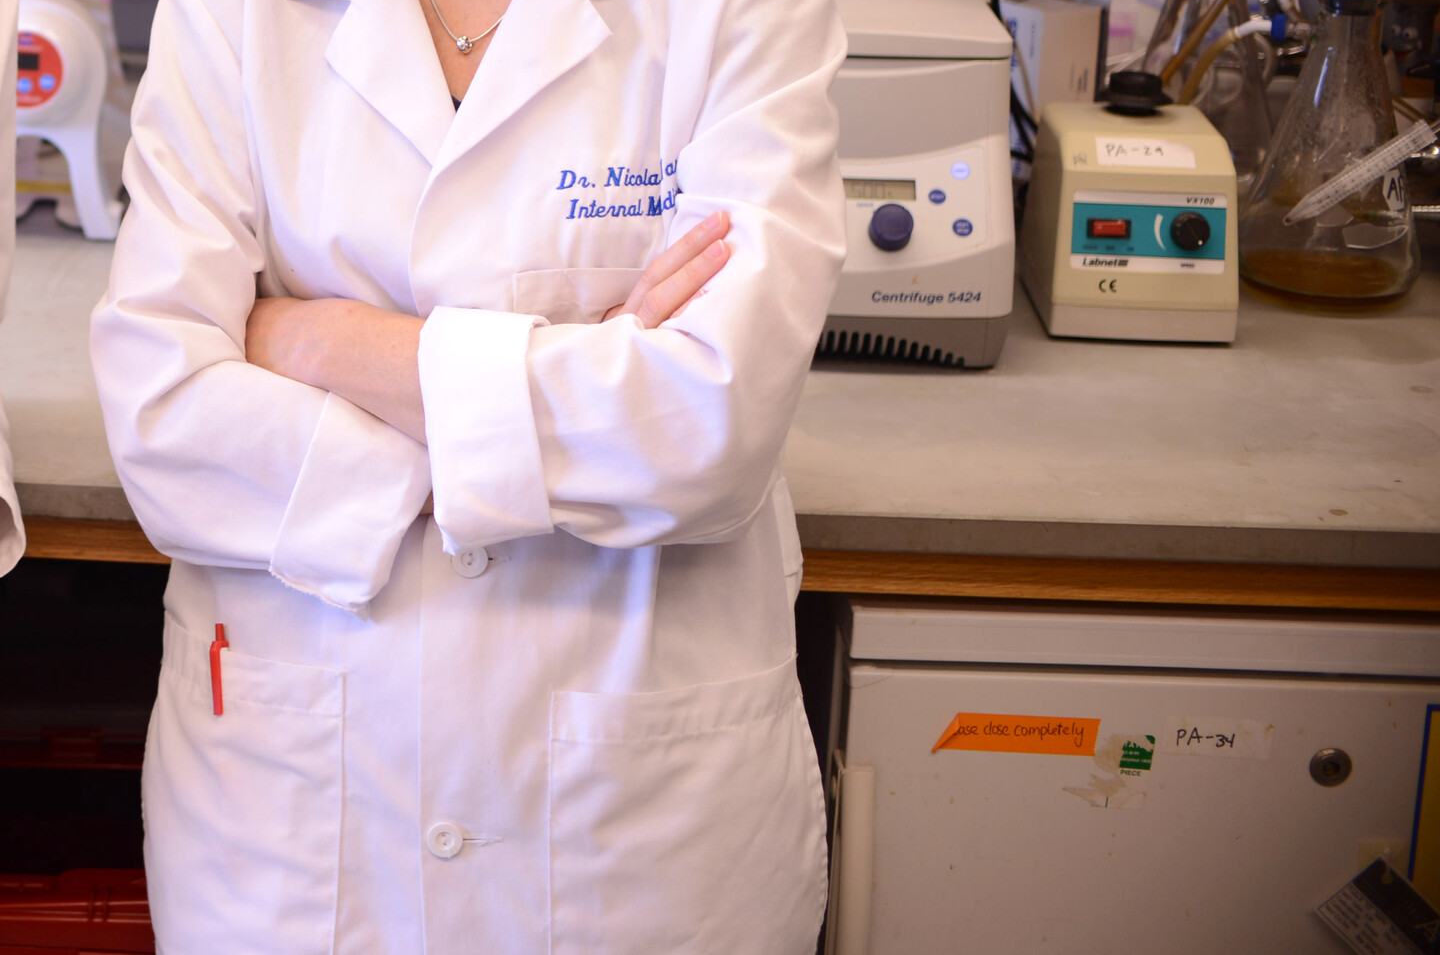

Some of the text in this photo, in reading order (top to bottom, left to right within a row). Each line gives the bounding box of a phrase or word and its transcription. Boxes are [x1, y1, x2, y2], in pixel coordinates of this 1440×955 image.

[556, 170, 596, 190] Dr.
[566, 199, 644, 219] Internal
[1186, 196, 1215, 206] VX100
[1083, 257, 1118, 267] Labnet
[871, 291, 981, 304] Centrifuge 5424
[982, 722, 1010, 737] close
[1013, 723, 1085, 748] completely
[1176, 727, 1236, 748] PA-34
